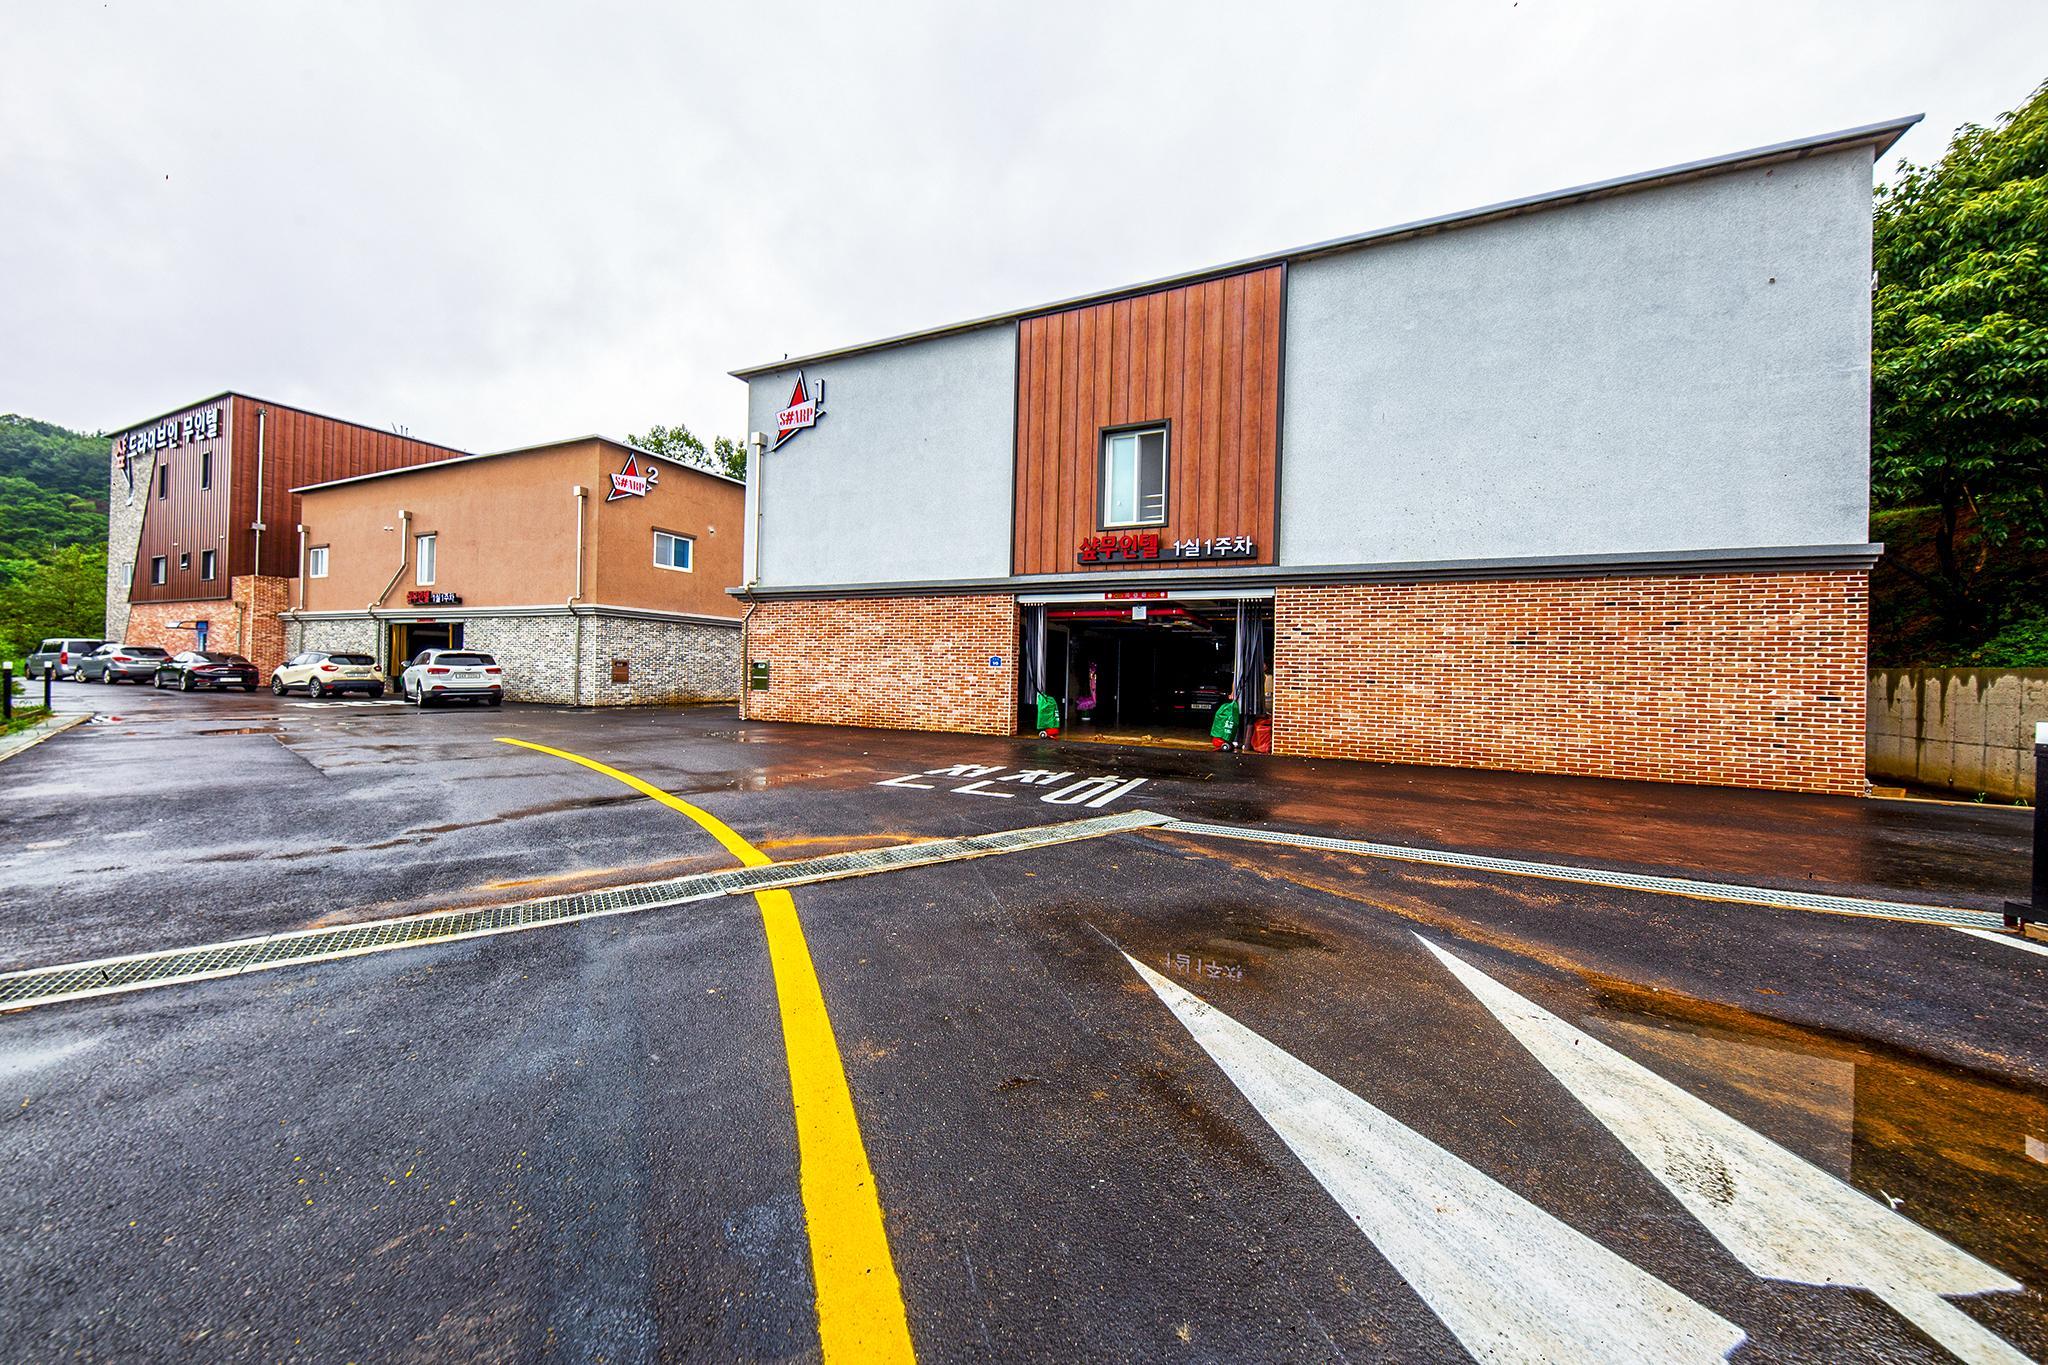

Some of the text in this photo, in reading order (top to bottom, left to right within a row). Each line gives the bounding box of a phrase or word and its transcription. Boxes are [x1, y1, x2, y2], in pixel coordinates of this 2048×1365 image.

[127, 422, 179, 458] 드라이브인
[182, 408, 218, 443] 무인텔
[646, 466, 659, 484] 2
[1079, 534, 1253, 561] 샵무인텔 1실 1주차
[873, 764, 1149, 808] 천천히
